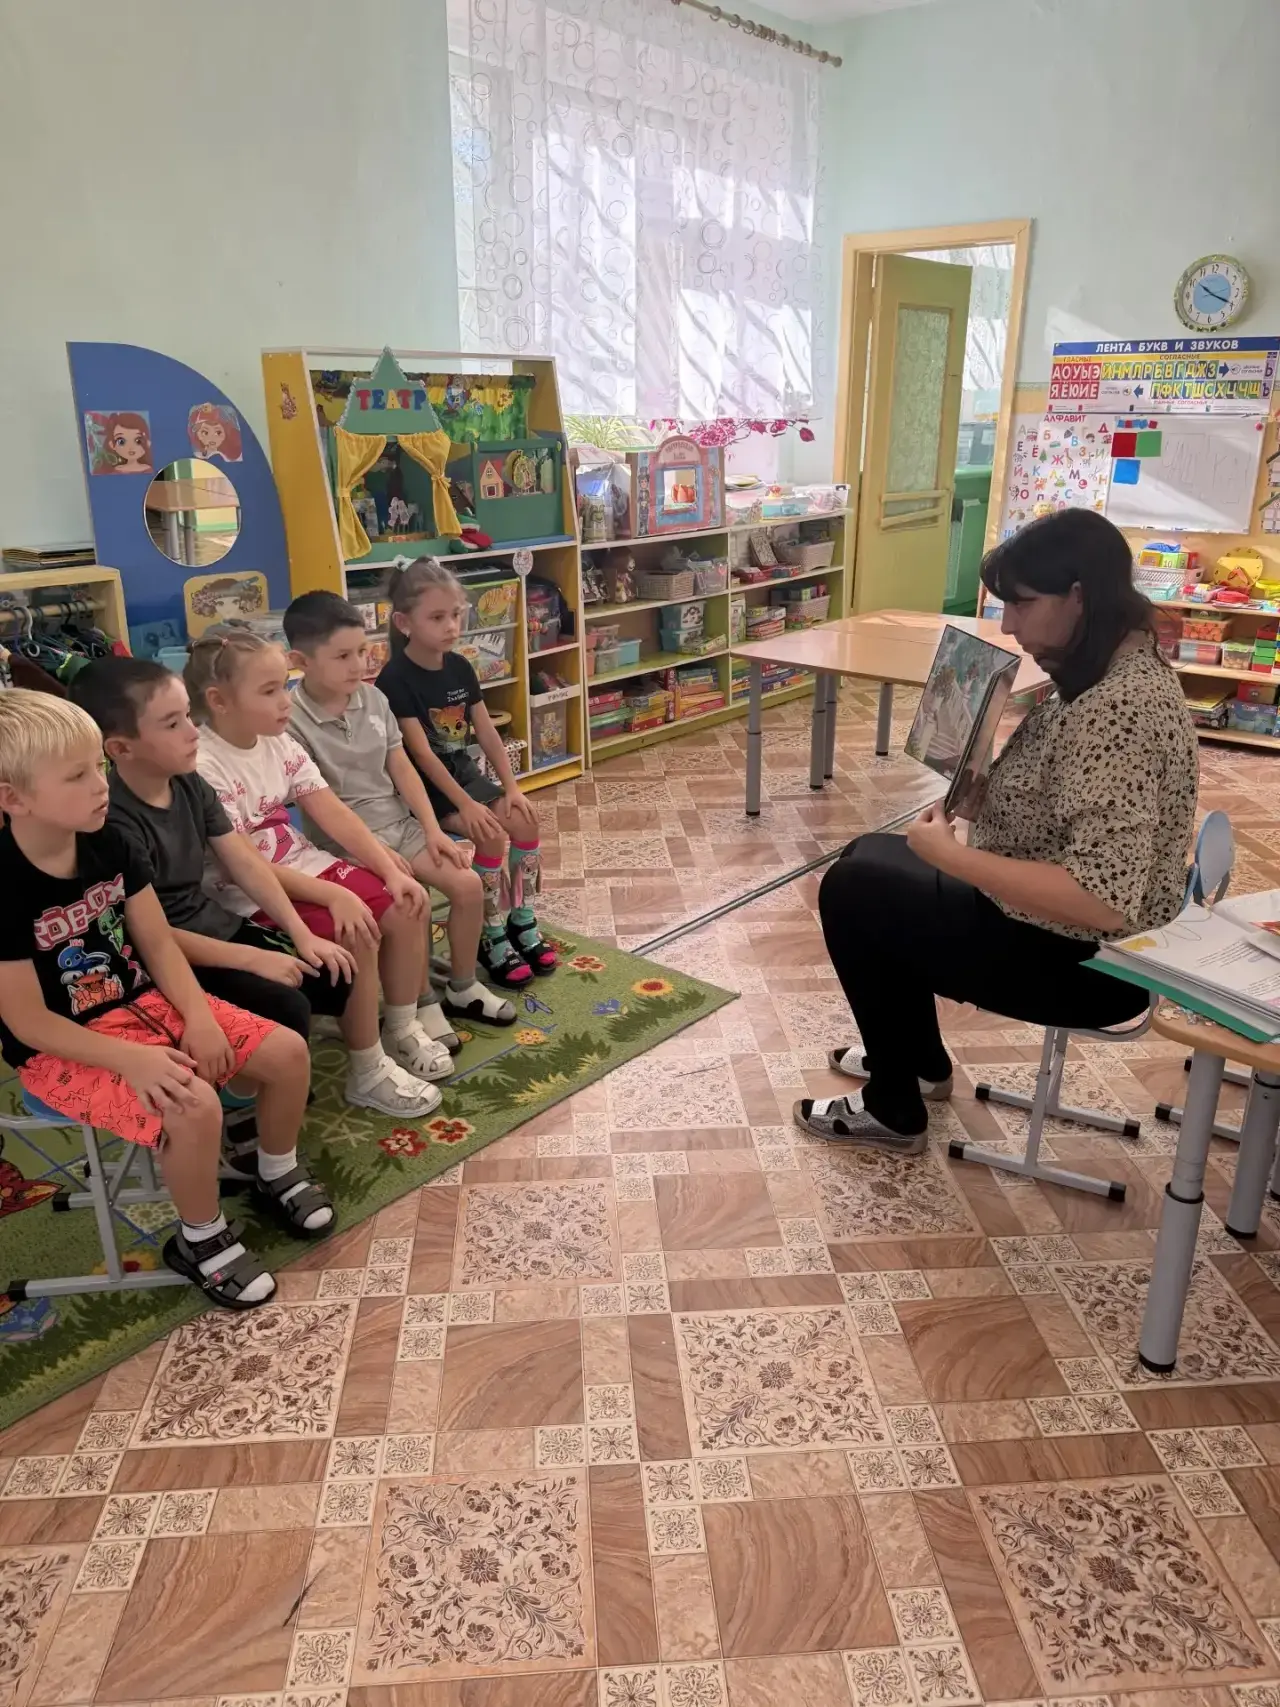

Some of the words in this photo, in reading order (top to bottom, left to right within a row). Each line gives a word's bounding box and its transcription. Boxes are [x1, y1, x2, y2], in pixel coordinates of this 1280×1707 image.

[1200, 268, 1206, 278] 11
[1212, 264, 1220, 274] 12
[1225, 266, 1229, 276] 1
[1189, 278, 1196, 288] 10
[1231, 275, 1237, 285] 2
[1186, 292, 1190, 300] 9
[1234, 288, 1240, 298] 3
[1188, 304, 1193, 314] 8
[1195, 312, 1201, 321] 7
[1207, 314, 1212, 324] 6
[1220, 310, 1225, 319] 5
[1096, 343, 1132, 353] ЛЕНТА
[1138, 342, 1168, 352] БУКВ
[1174, 341, 1184, 351] И
[1190, 340, 1239, 351] ЗВУКОВ
[356, 388, 427, 411] ТЕАТР
[1044, 414, 1087, 423] АЛФАВИТ
[1018, 424, 1026, 435] А
[1043, 430, 1051, 440] Б
[1071, 436, 1078, 446] В
[1098, 422, 1109, 433] Д
[1017, 441, 1023, 452] Е
[1032, 445, 1039, 458] Ё
[1051, 455, 1064, 465] Ж
[1079, 446, 1086, 457] З
[1014, 464, 1023, 476] Й
[1032, 466, 1040, 476] К
[1069, 469, 1080, 480] М
[1099, 475, 1107, 484] Н
[1020, 489, 1029, 499] О
[1064, 489, 1072, 499] С
